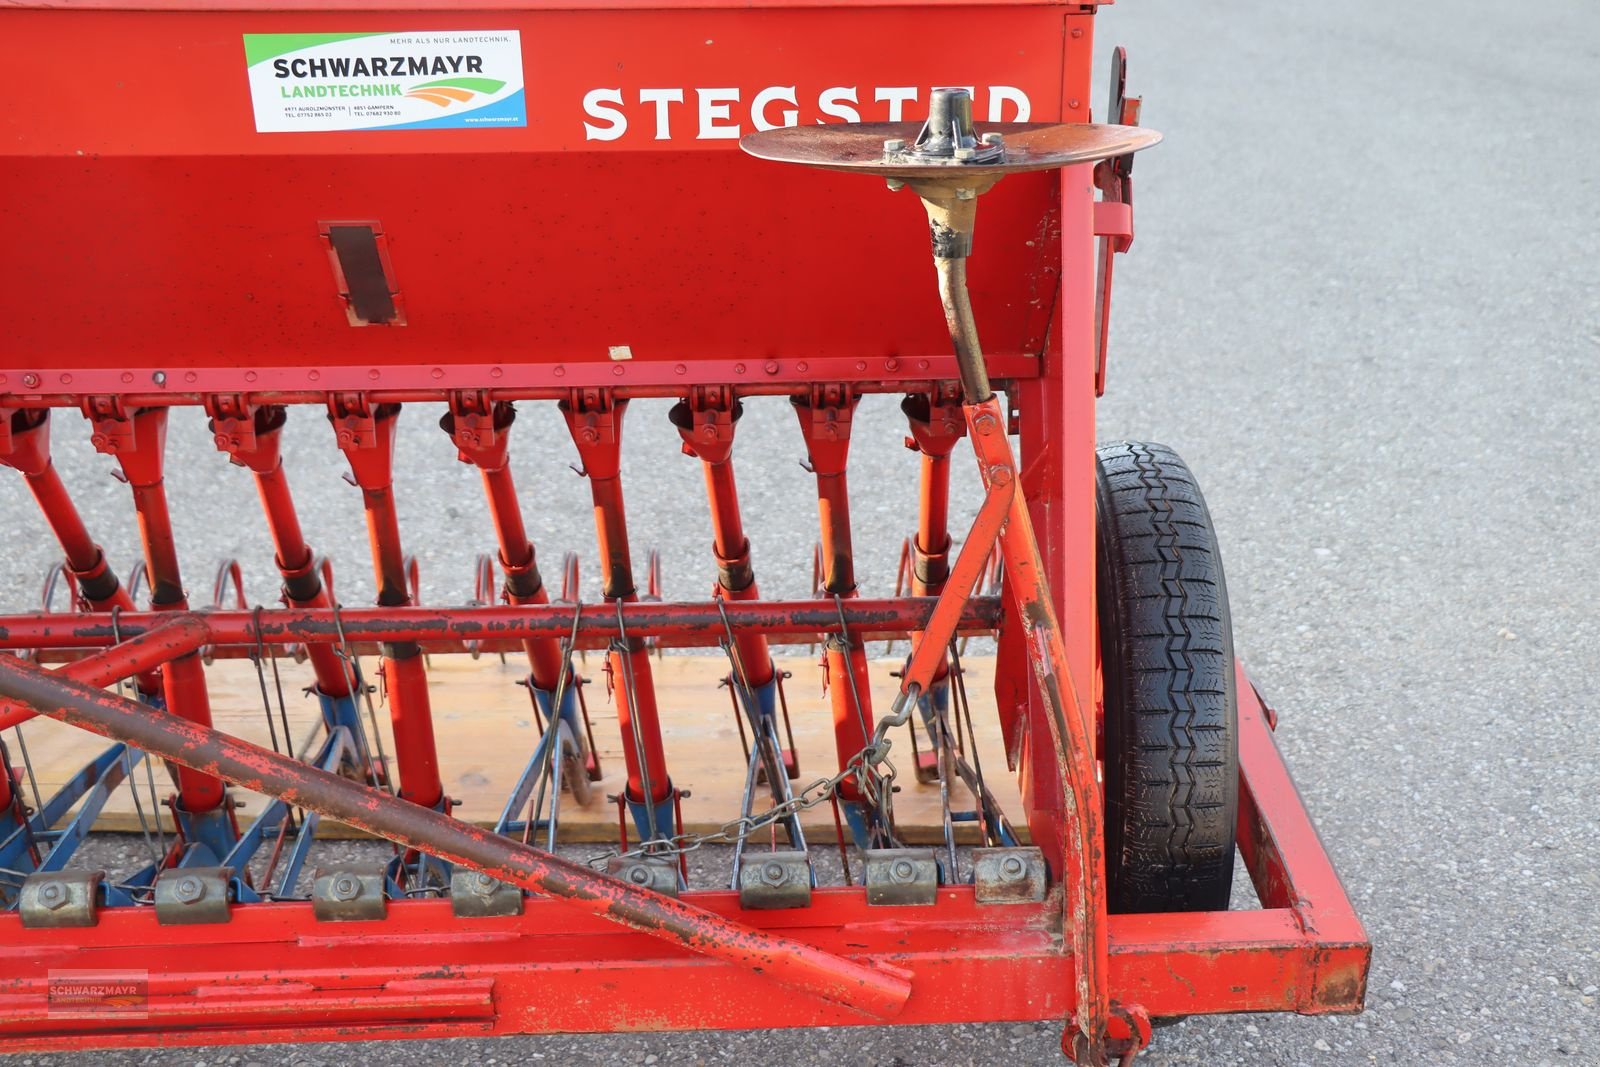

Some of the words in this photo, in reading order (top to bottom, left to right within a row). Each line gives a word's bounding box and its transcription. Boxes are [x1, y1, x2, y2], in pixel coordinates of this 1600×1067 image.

[273, 55, 483, 78] SCHWARZMAYR
[281, 83, 403, 98] LANDTECHNIK
[582, 85, 1032, 141] STEGSTD
